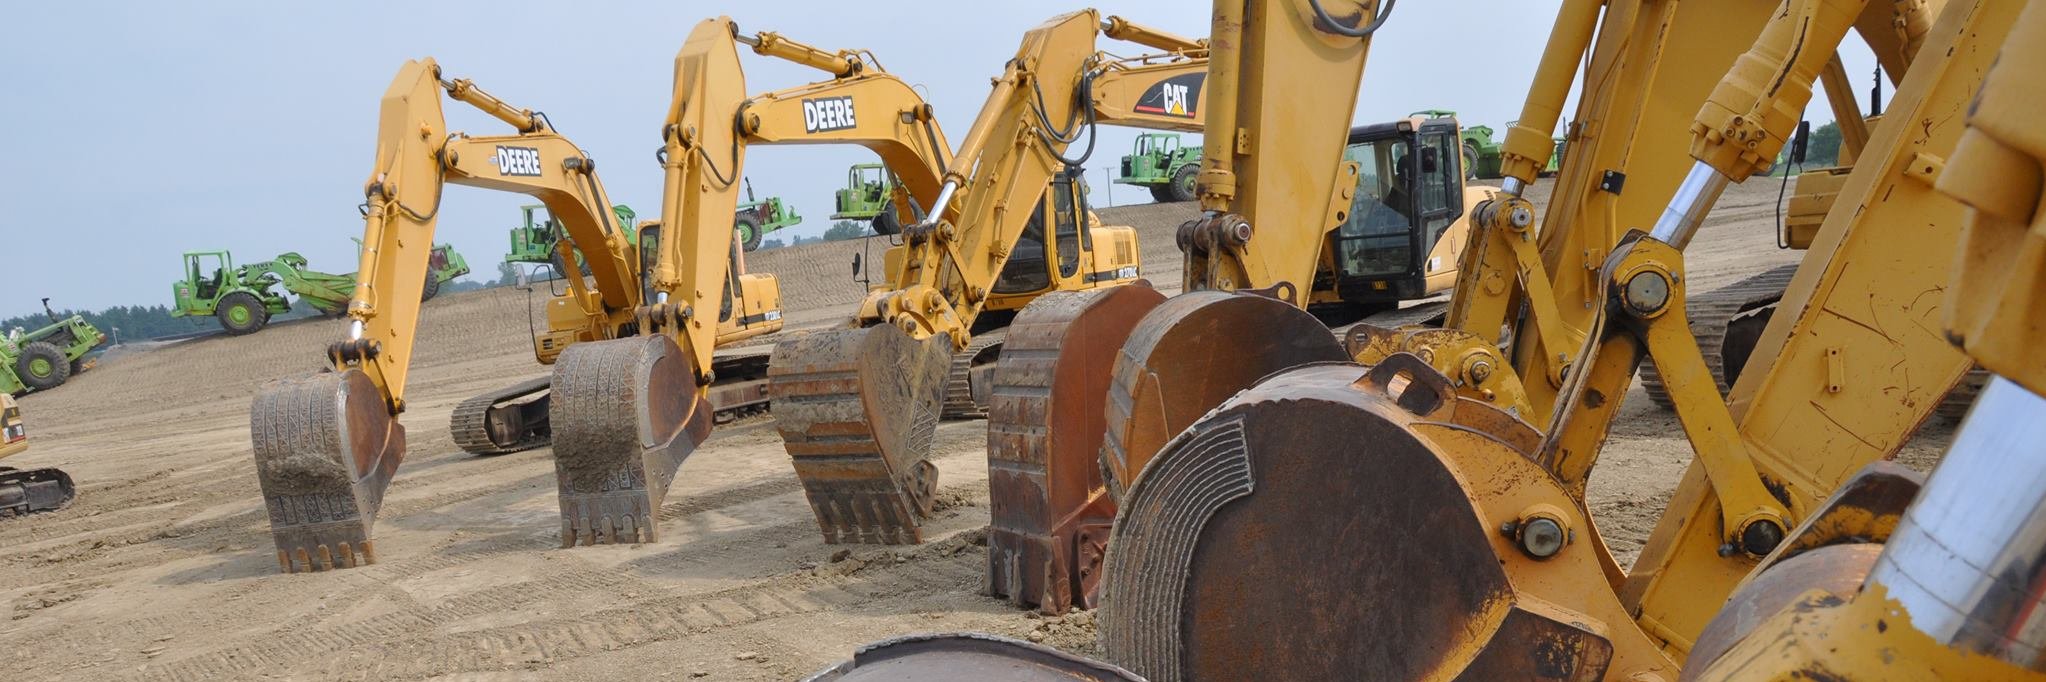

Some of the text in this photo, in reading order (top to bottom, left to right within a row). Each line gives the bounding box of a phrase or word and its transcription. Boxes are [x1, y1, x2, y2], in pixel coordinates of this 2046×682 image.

[803, 98, 855, 131] DEERE
[1163, 82, 1188, 116] CAT
[497, 147, 541, 175] DEERE
